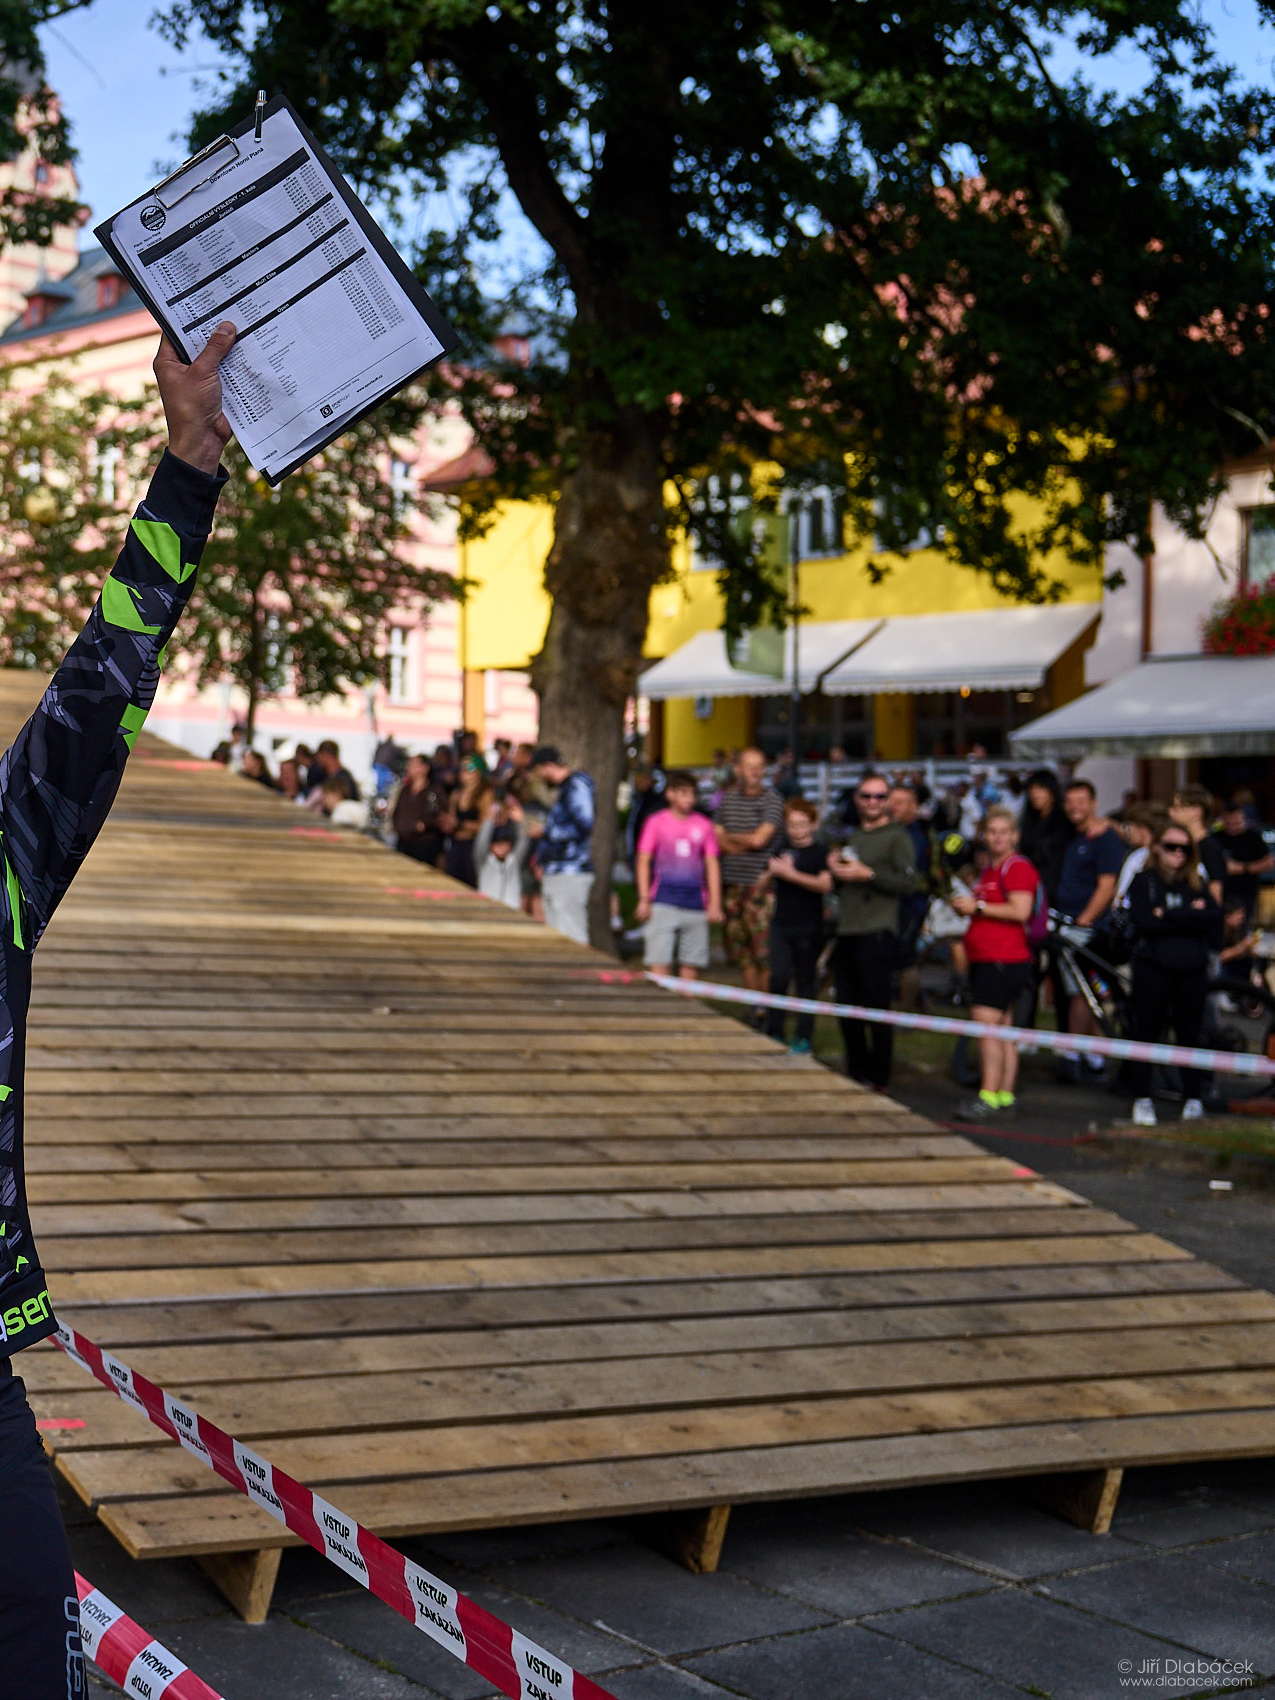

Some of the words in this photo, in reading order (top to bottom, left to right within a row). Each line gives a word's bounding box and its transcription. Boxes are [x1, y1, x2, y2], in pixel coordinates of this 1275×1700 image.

[240, 245, 260, 259] Masters
[276, 302, 290, 313] Open
[109, 1362, 128, 1383] VSTUP
[171, 1406, 193, 1429] VSTUP
[242, 1455, 266, 1480] VSTUP
[322, 1511, 350, 1540] VSTUP
[416, 1575, 448, 1608] VSTUP
[525, 1650, 562, 1688] VSTUP
